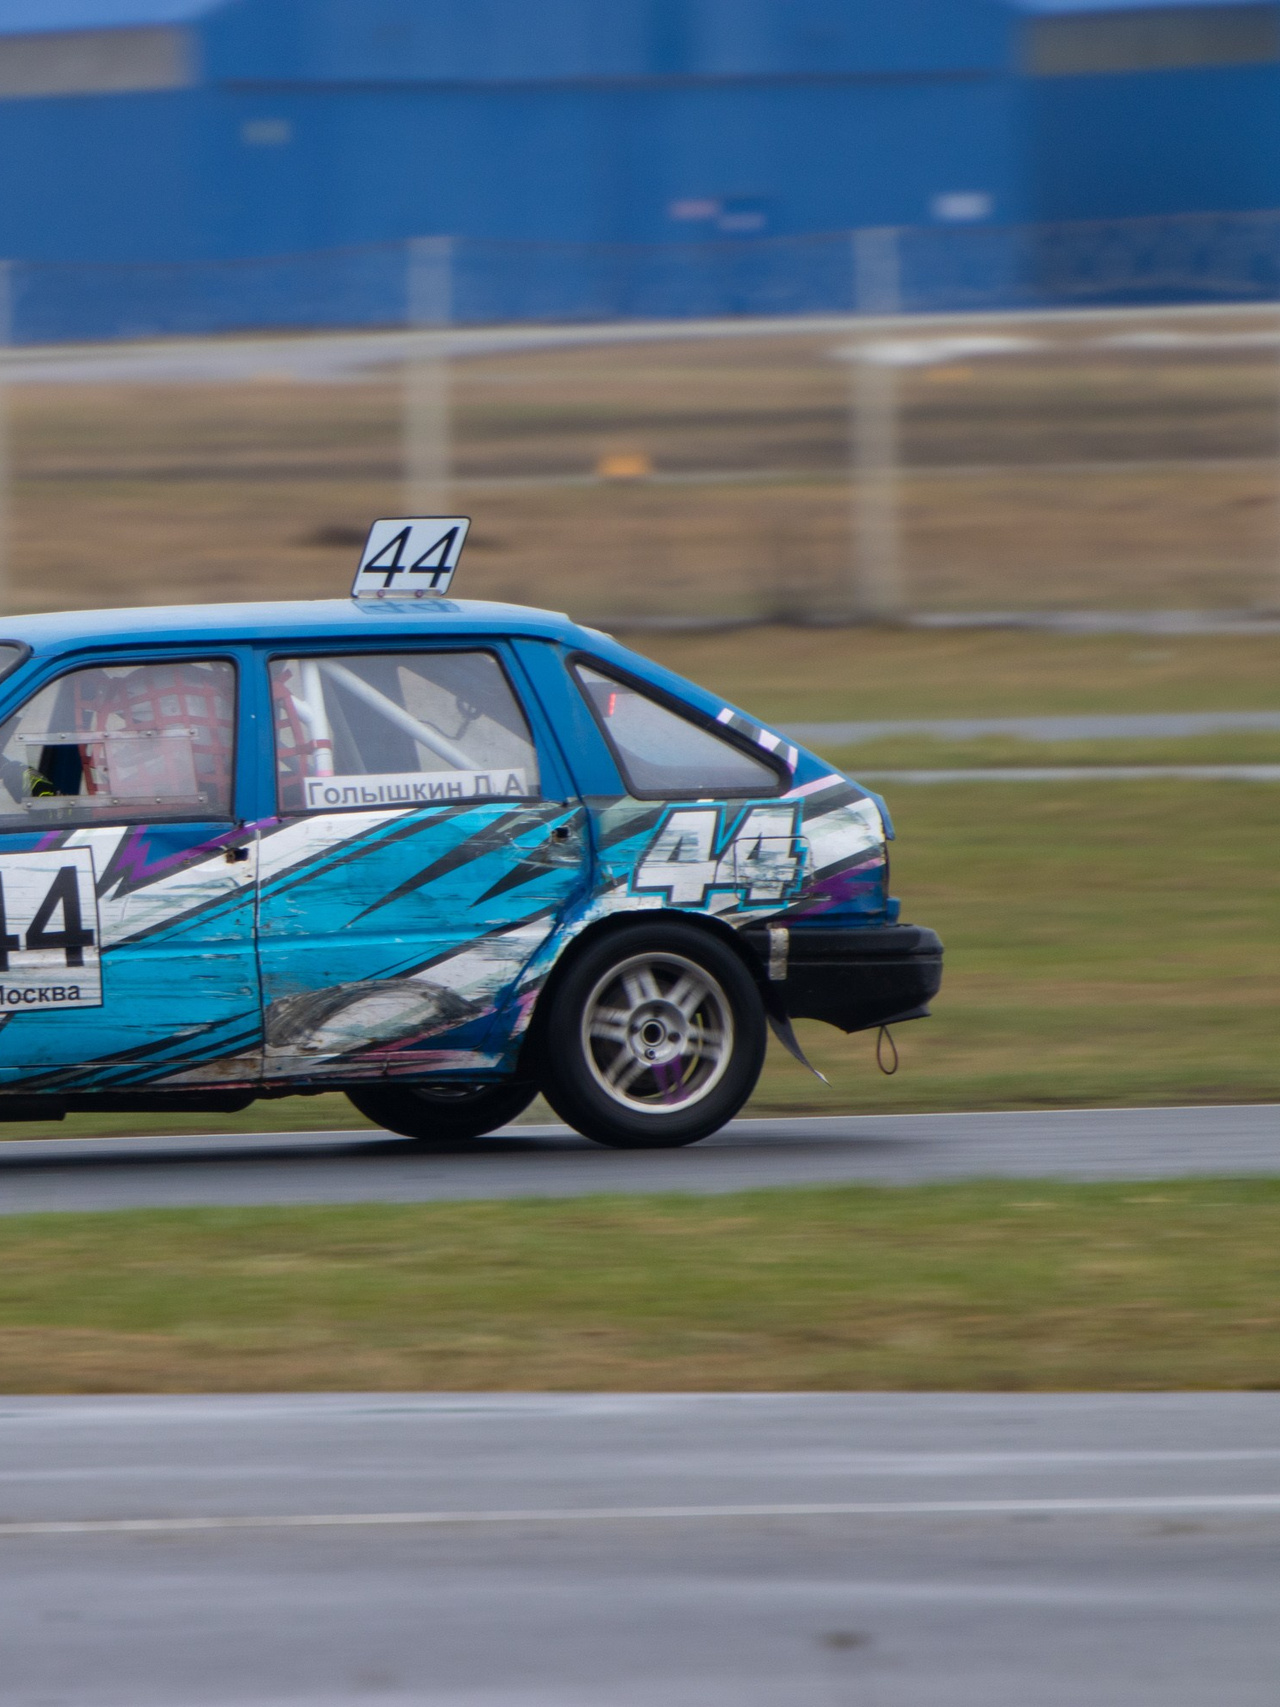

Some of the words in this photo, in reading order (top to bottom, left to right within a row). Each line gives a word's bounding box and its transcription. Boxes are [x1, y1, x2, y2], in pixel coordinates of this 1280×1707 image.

[362, 526, 460, 588] 44
[307, 781, 463, 805] Голышкин
[630, 802, 804, 908] 44
